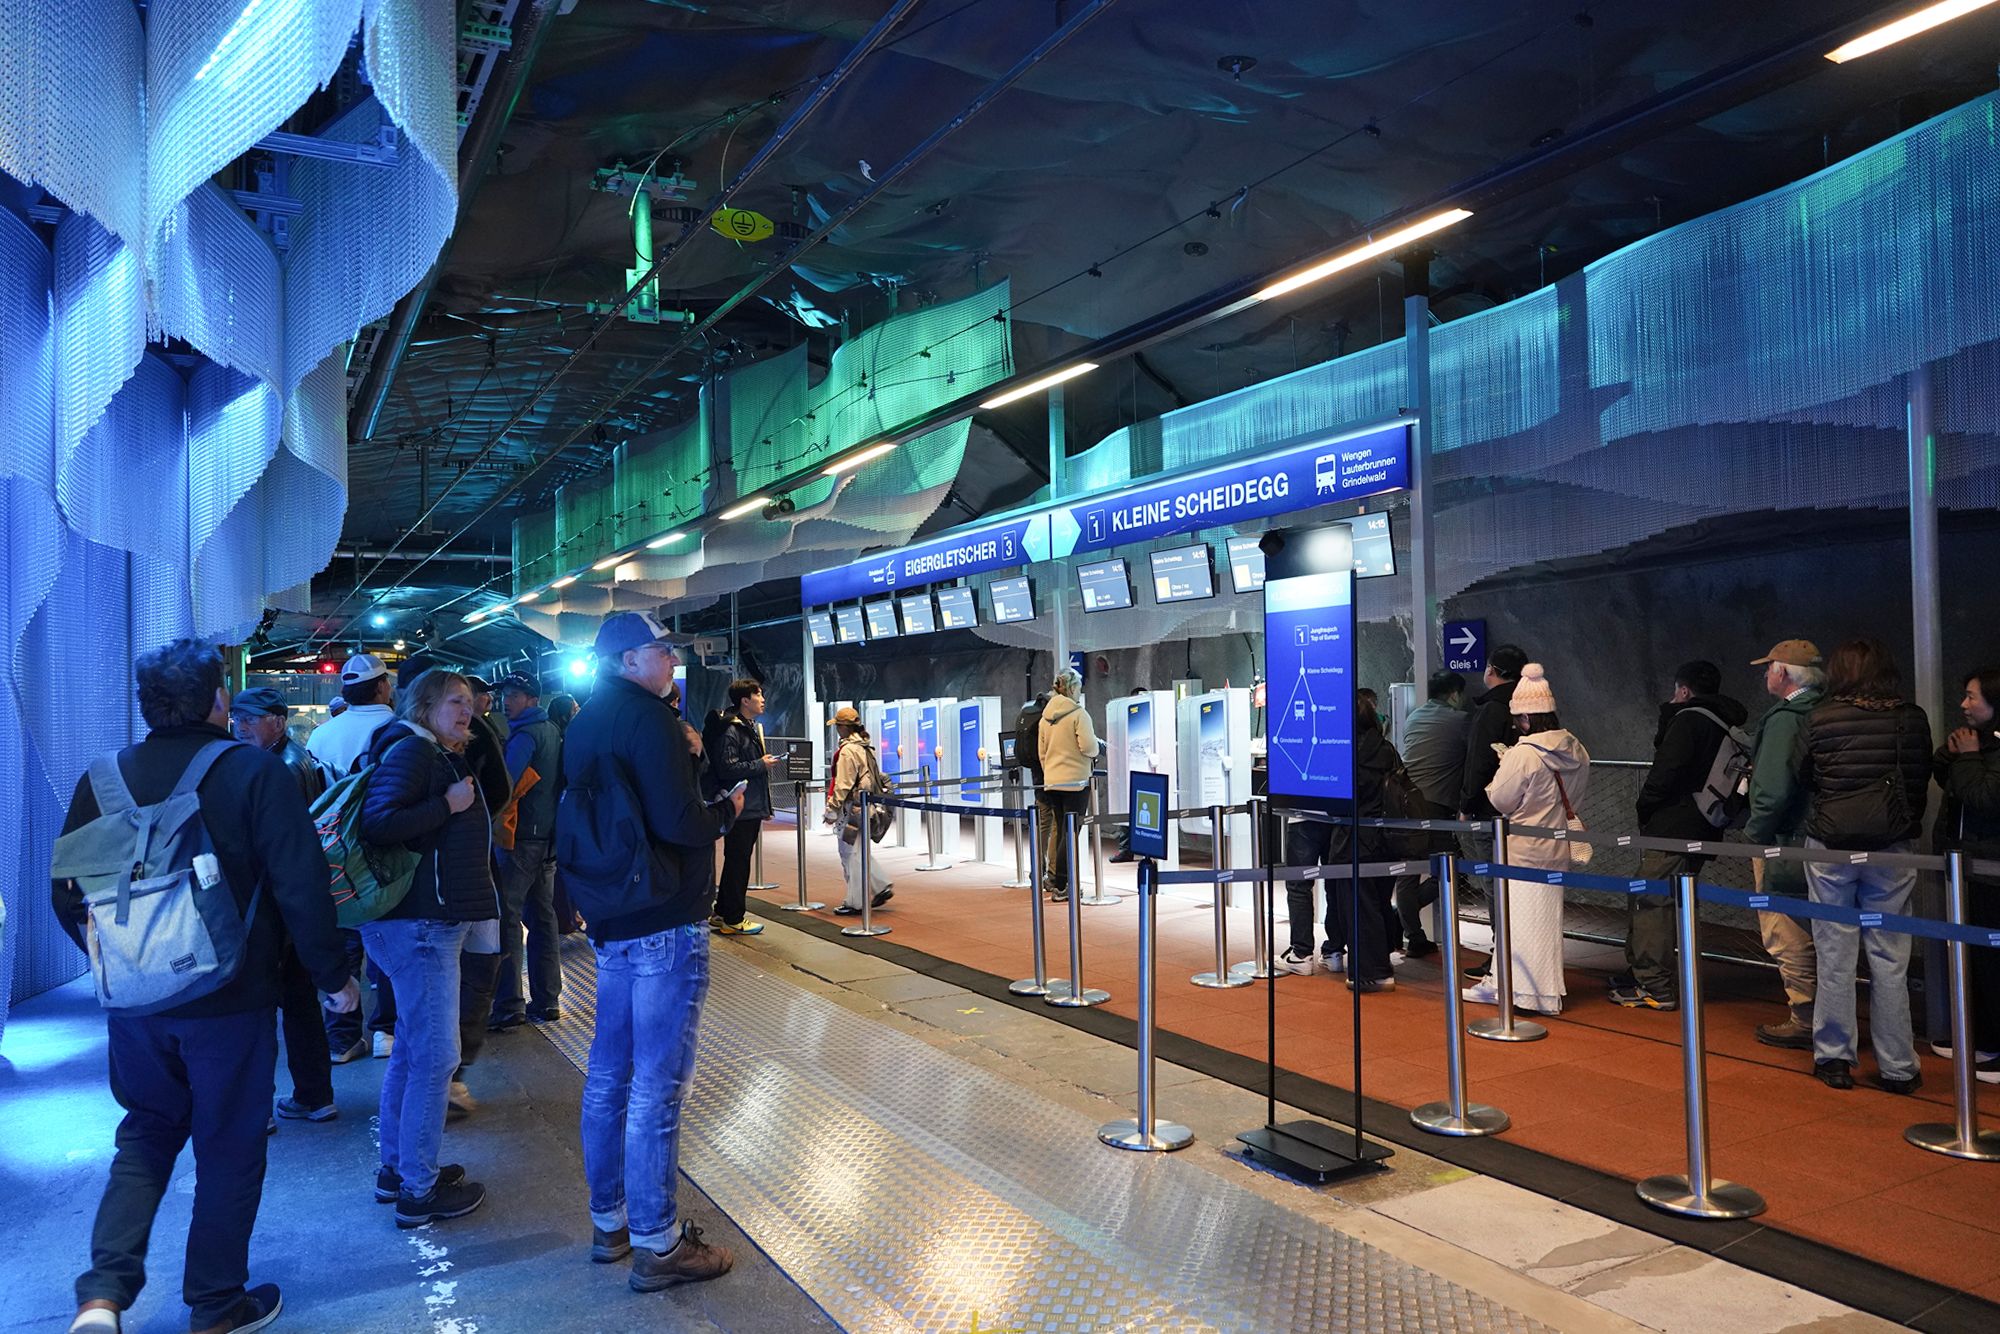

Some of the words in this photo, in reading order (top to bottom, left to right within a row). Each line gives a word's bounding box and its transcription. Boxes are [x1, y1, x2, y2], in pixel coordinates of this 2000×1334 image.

[1341, 449, 1372, 462] Wengen
[1342, 457, 1396, 475] Lauterbrunnen
[1342, 471, 1387, 488] Grindelwald
[1092, 519, 1099, 537] 1
[1112, 499, 1170, 532] KLEINE
[1175, 472, 1289, 519] SCHEIDEGG
[1367, 519, 1386, 530] 14:15
[905, 540, 997, 577] EIGERGLETSCHER
[1005, 539, 1013, 557] 3
[1299, 631, 1304, 643] 1
[1449, 659, 1472, 669] Gleis
[1473, 659, 1478, 668] 1
[1141, 830, 1163, 840] Reservation
